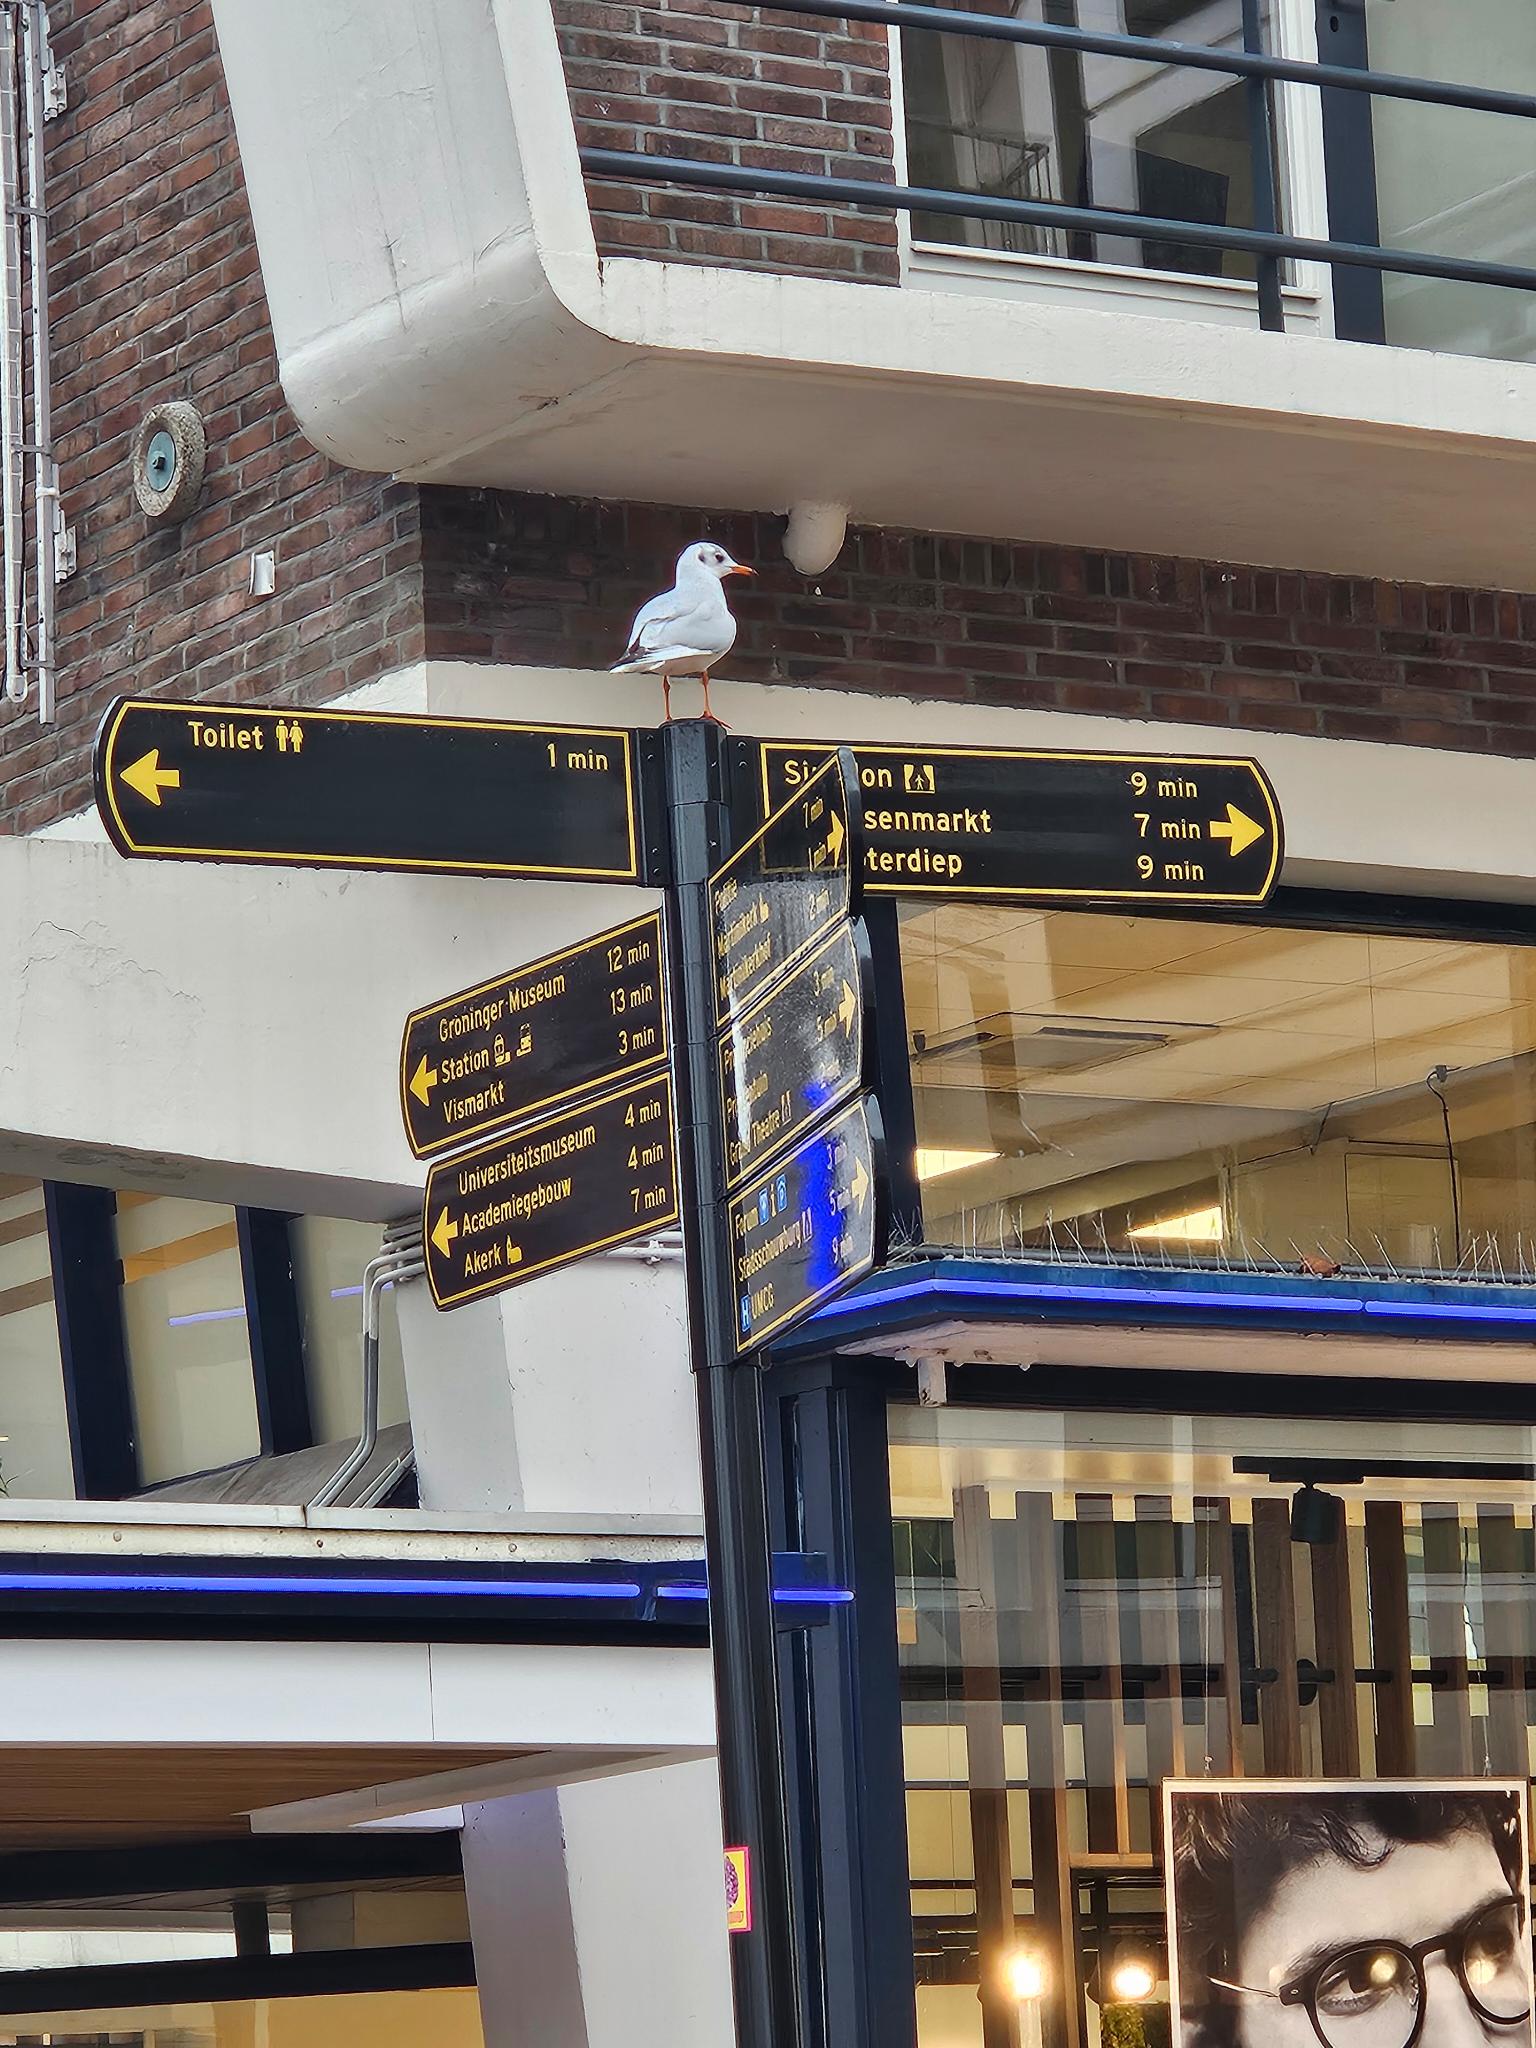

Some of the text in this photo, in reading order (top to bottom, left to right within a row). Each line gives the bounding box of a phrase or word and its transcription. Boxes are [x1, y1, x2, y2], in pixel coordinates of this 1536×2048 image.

[188, 721, 609, 771] Toilet 1 min
[1130, 772, 1147, 797] 9
[1158, 774, 1198, 798] min
[1134, 814, 1151, 838] 7
[1161, 817, 1202, 840] min
[1136, 855, 1154, 880] 9
[1165, 859, 1205, 882] min
[439, 940, 651, 1043] Groninger Museum 12 min
[441, 983, 653, 1085] Station 13 min
[443, 1026, 656, 1124] Vismarkt 3 min
[458, 1098, 662, 1196] Universiteitsmuseum 4 min
[462, 1141, 664, 1237] Academiegebouw 4 min
[464, 1185, 667, 1278] Akerk 7 min
